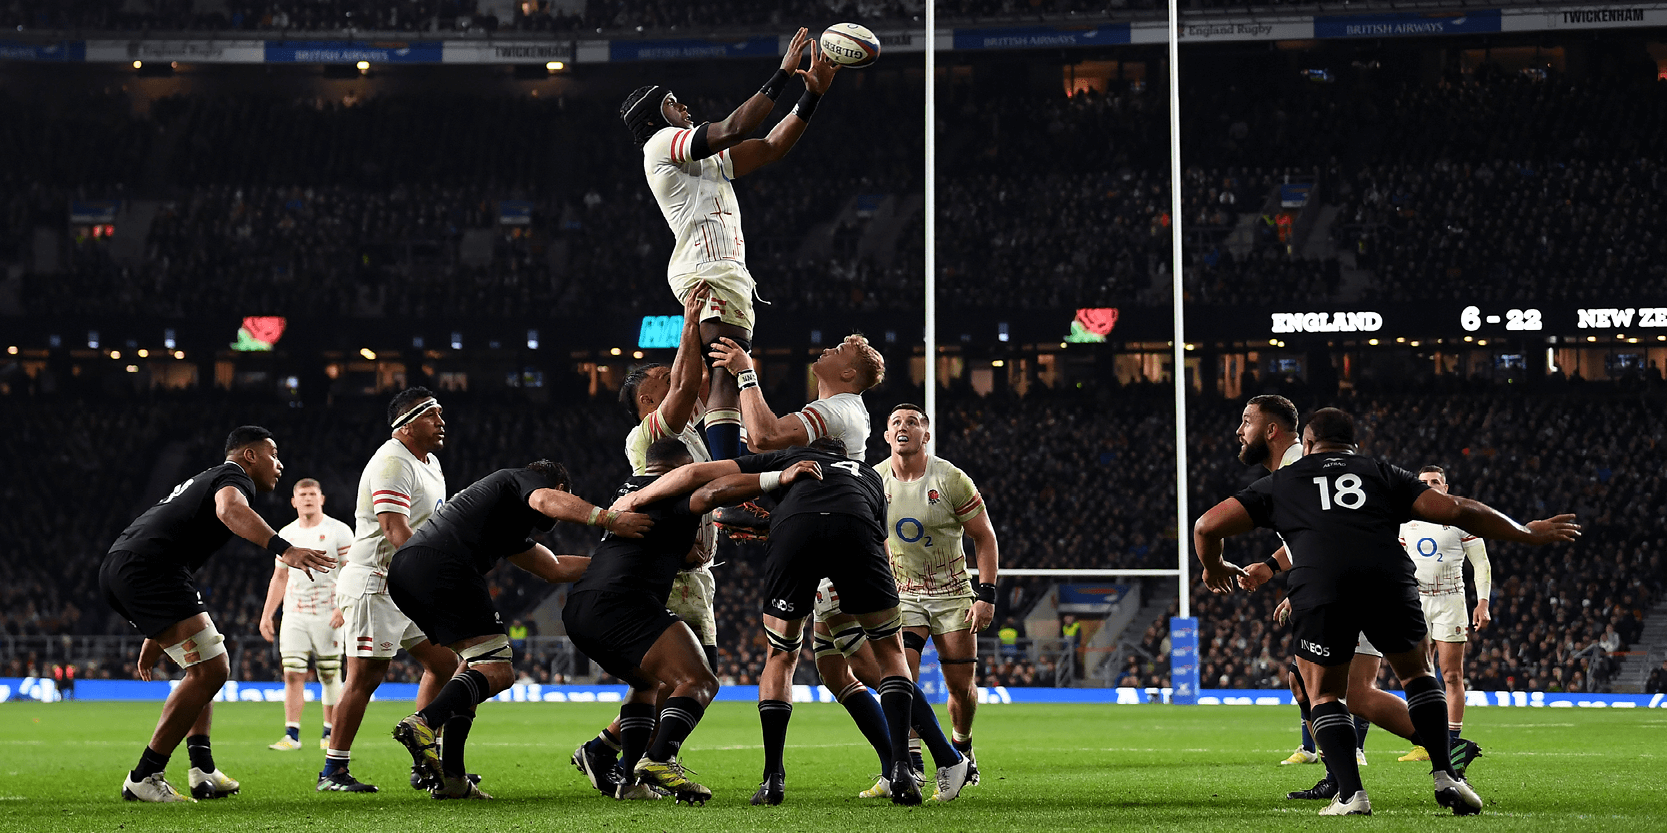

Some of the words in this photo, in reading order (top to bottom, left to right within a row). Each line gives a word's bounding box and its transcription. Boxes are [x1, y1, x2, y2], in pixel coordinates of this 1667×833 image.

[1563, 9, 1644, 23] TWICKENHAM
[1189, 24, 1234, 37] England
[1237, 23, 1272, 36] Rugby
[1346, 24, 1392, 36] BRITISH
[1394, 22, 1443, 34] AIRWAYS
[1271, 312, 1383, 333] ENGLAND
[1460, 306, 1481, 331] 6
[1505, 309, 1543, 331] 22
[1577, 308, 1636, 329] NEW
[830, 460, 863, 477] 4
[1313, 473, 1367, 511] 18
[1300, 638, 1330, 657] INEOS
